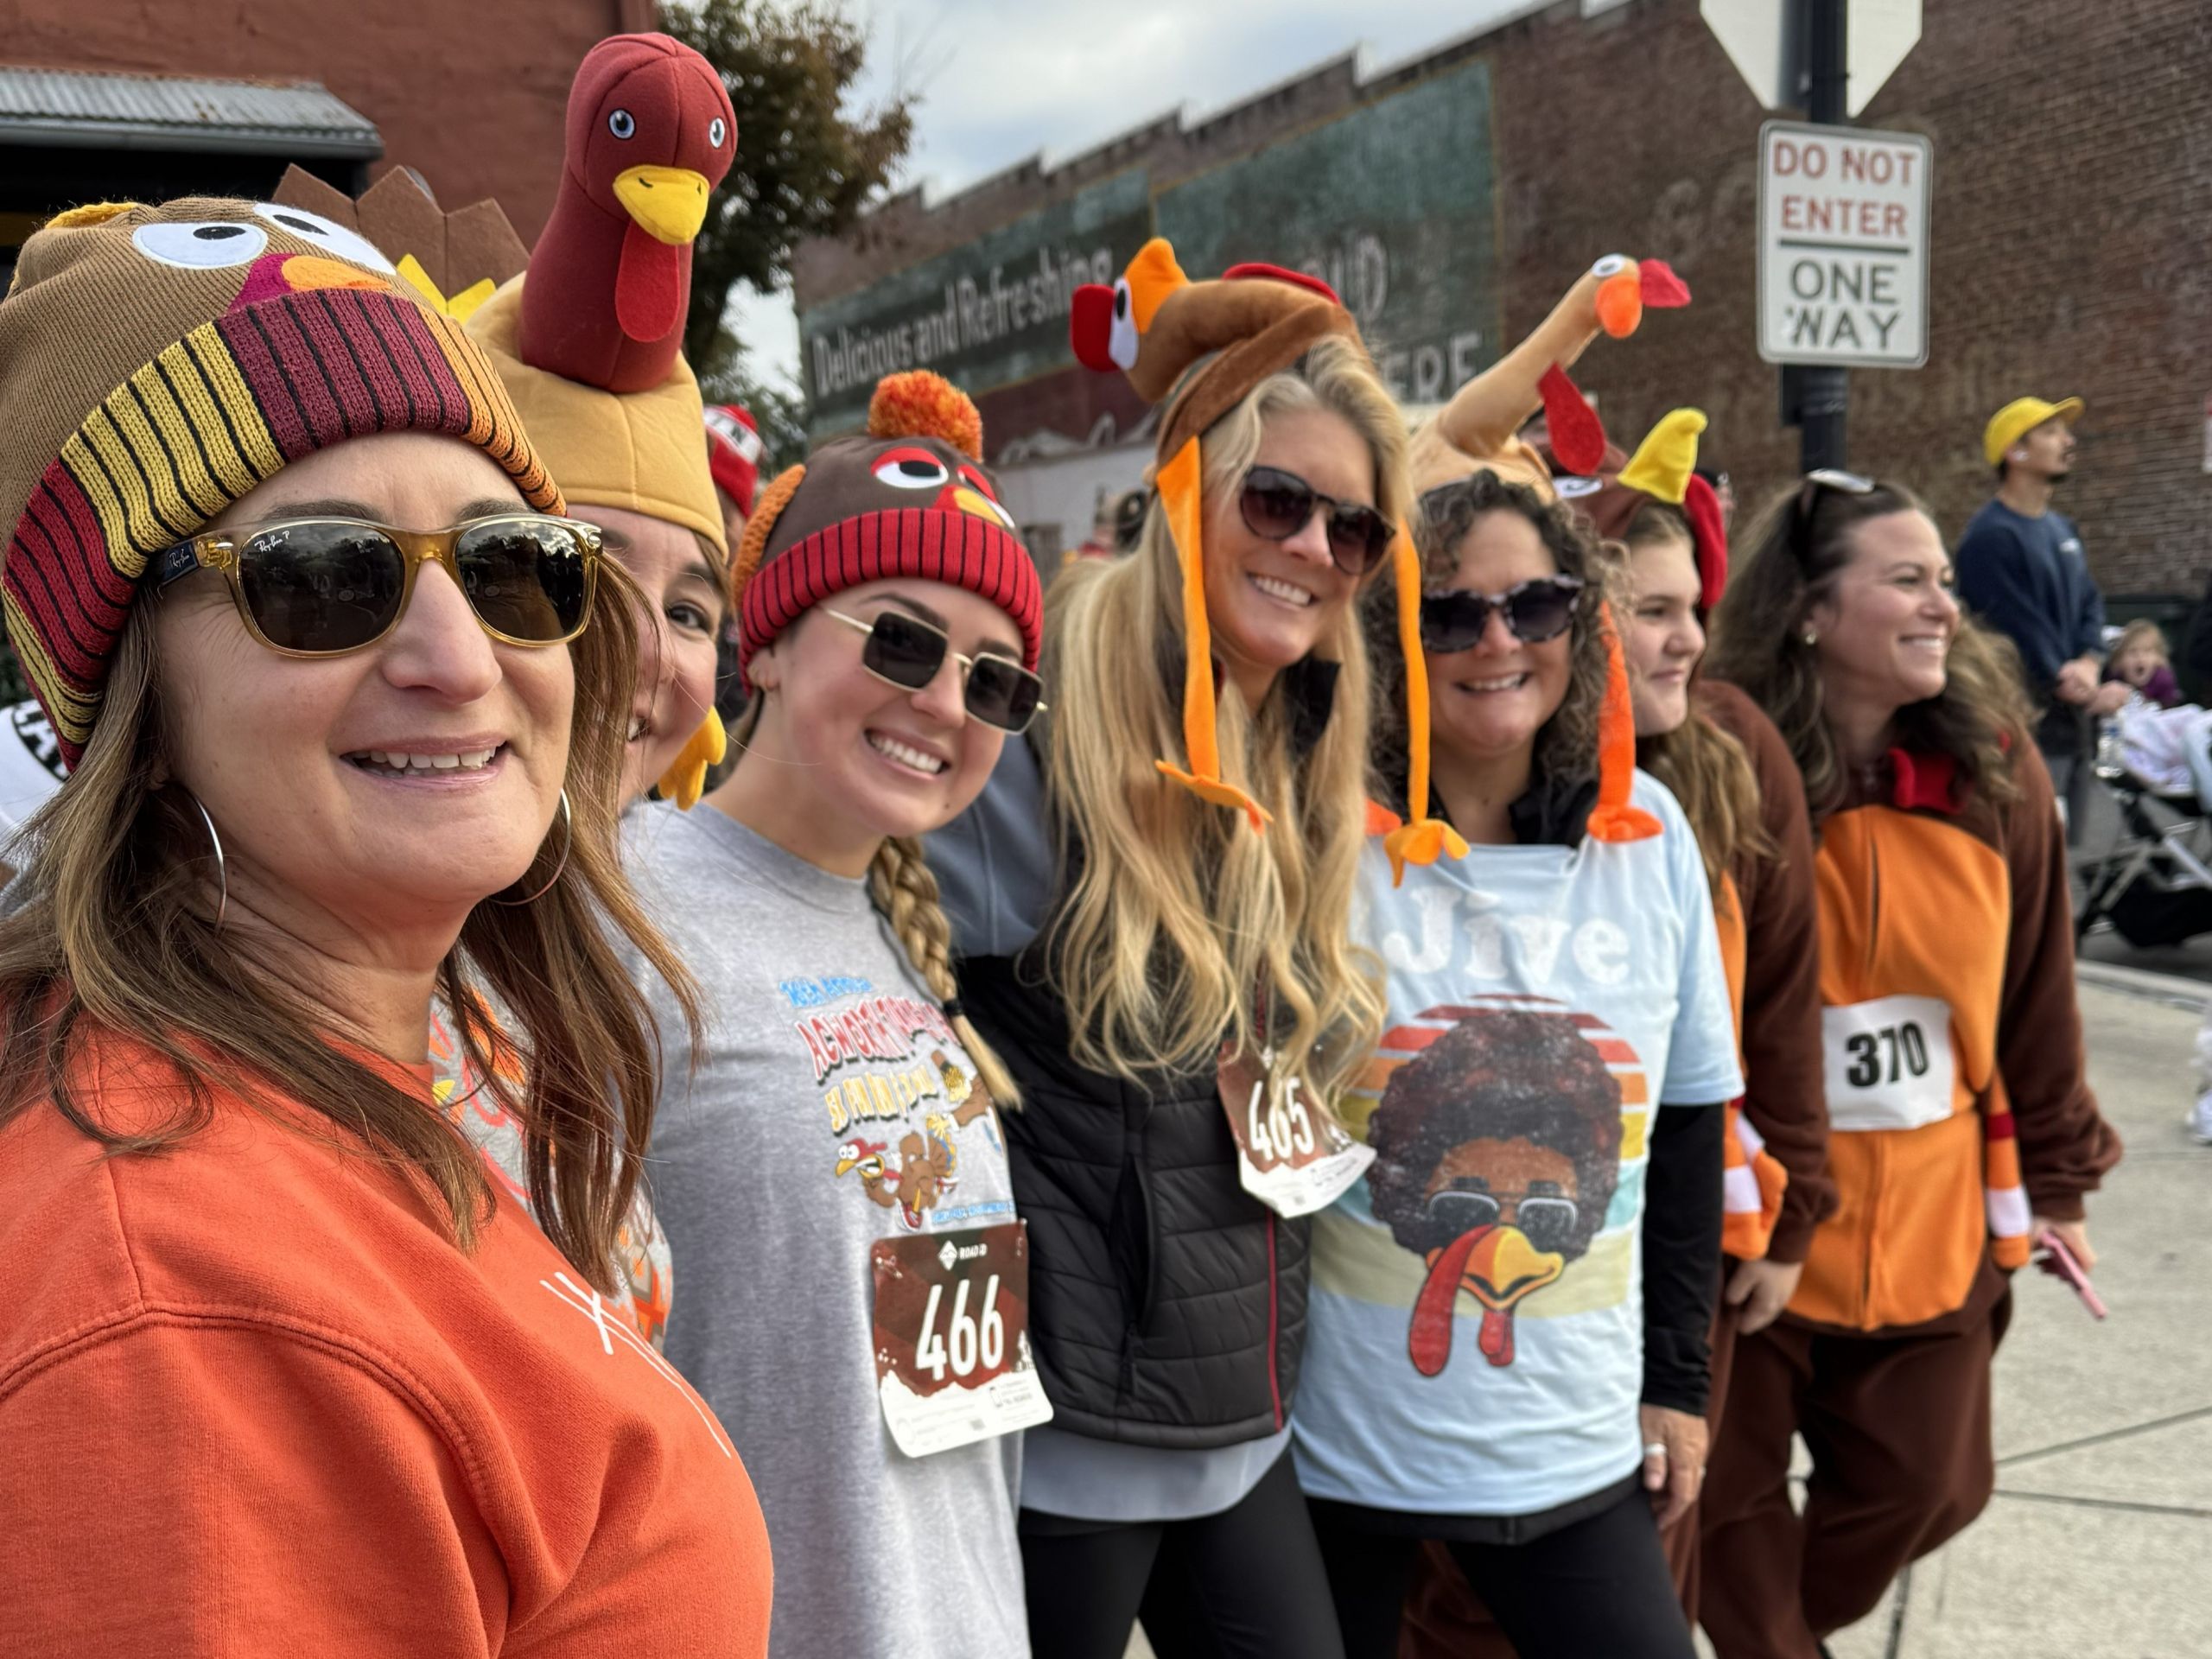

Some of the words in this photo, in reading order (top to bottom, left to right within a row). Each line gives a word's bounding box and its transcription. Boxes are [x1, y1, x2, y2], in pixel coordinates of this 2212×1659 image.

[1773, 140, 1827, 179] DO
[1840, 147, 1916, 185] NOT
[1781, 195, 1907, 236] ENTER
[1790, 259, 1897, 304] ONE
[812, 325, 912, 397] Delicious
[912, 283, 959, 363] and
[1785, 306, 1900, 349] WAY
[1382, 886, 1631, 984] Jive
[1845, 1021, 1929, 1088] 370
[1248, 1077, 1315, 1162] 465
[915, 1274, 1004, 1382] 466
